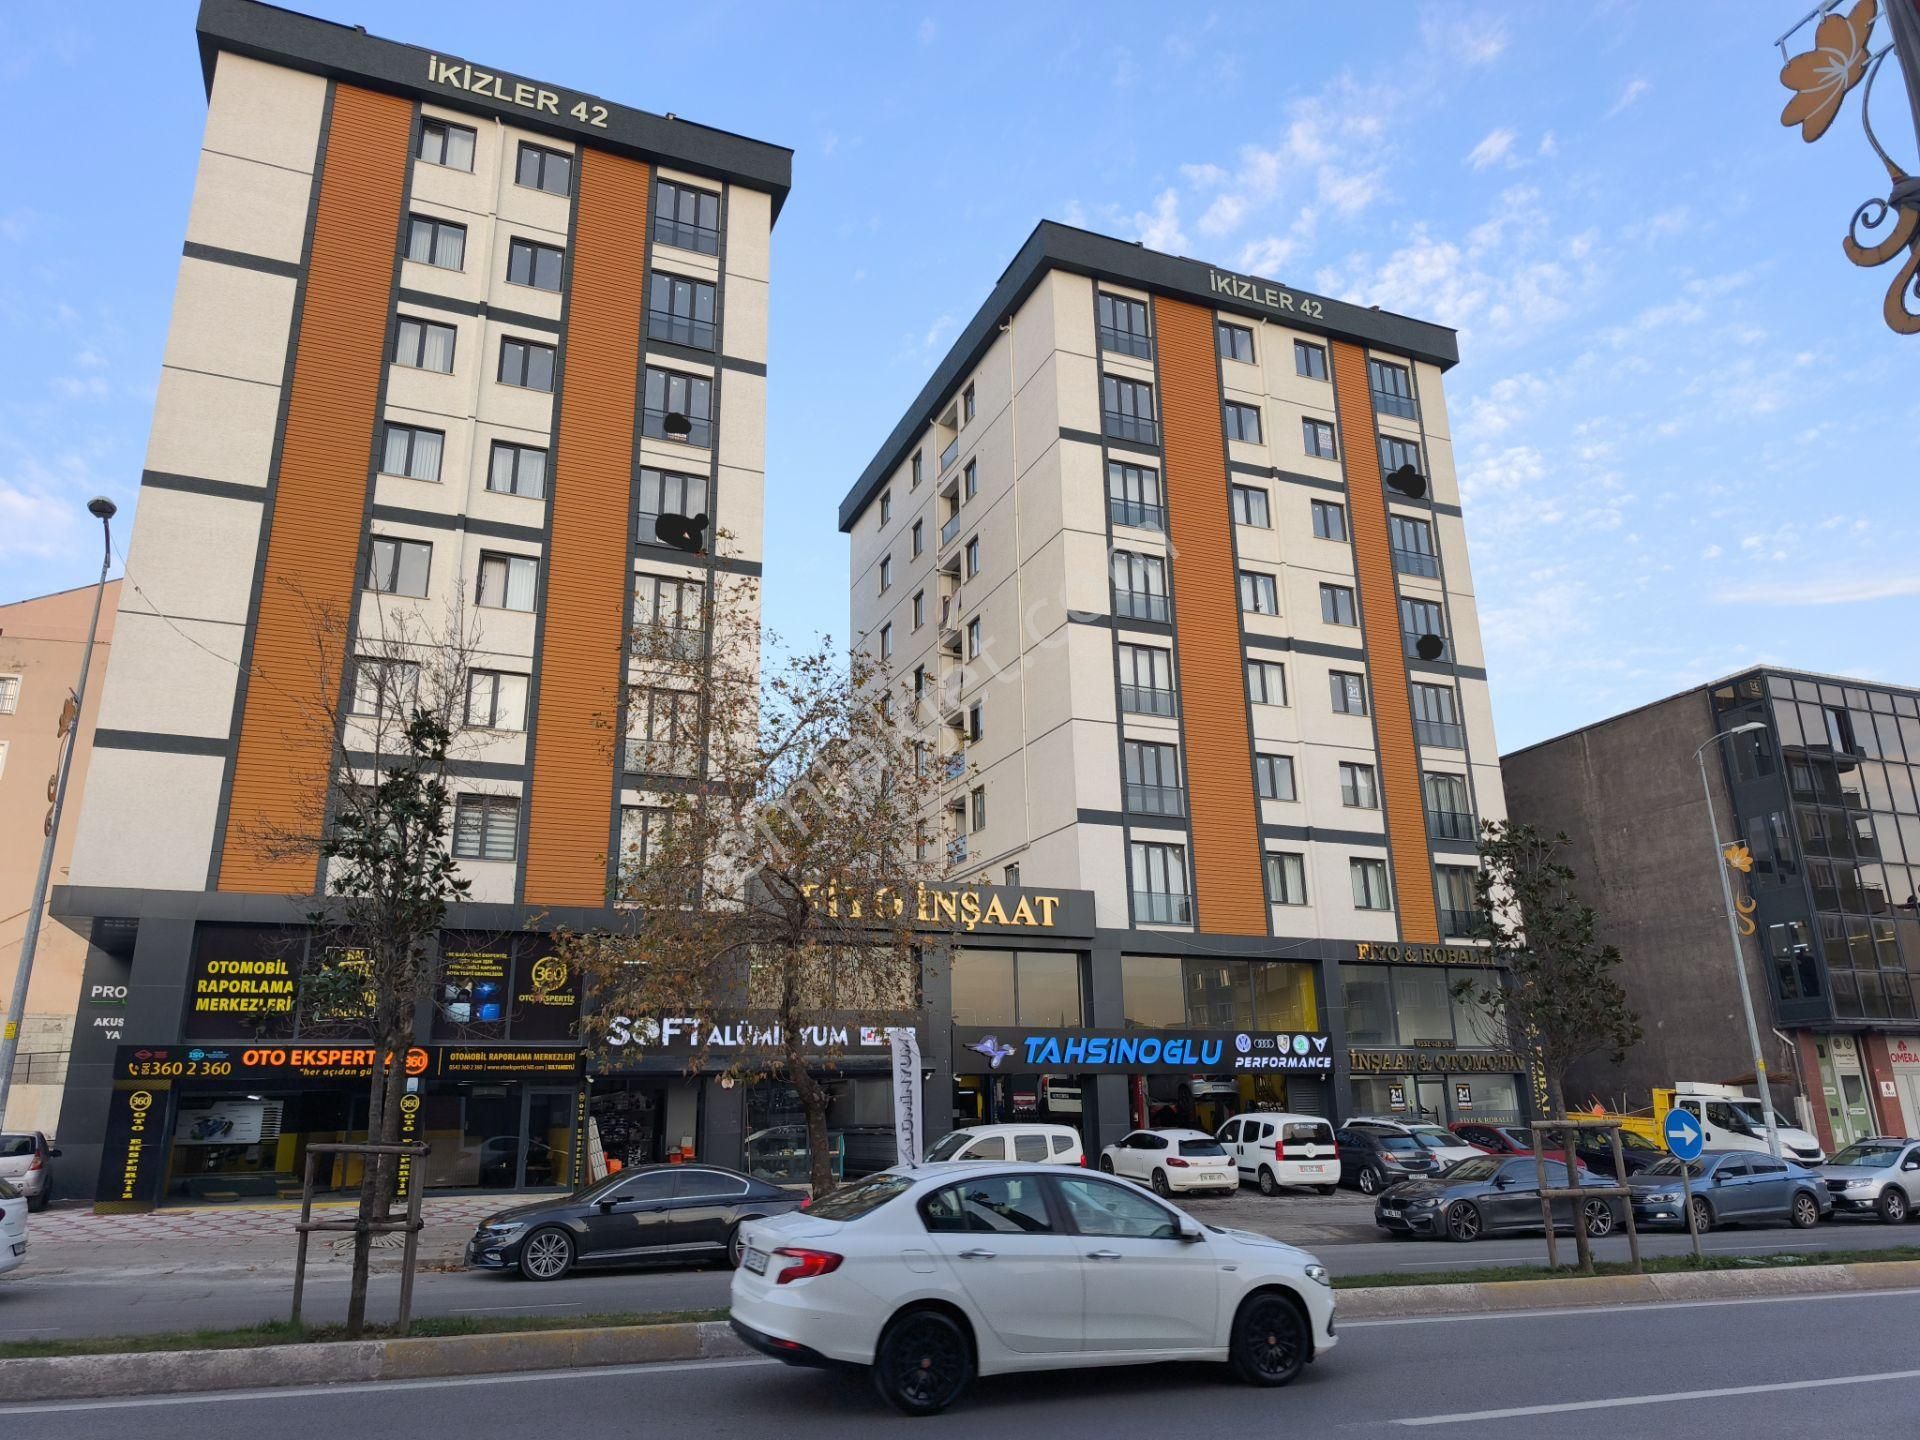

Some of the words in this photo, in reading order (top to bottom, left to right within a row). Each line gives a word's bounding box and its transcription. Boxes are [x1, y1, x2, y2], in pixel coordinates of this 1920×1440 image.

[428, 55, 559, 115] İKİZLER
[570, 101, 608, 128] 42
[1209, 269, 1295, 312] İKİZLER
[1300, 298, 1323, 319] 42
[1404, 945, 1419, 962] &
[207, 960, 289, 975] OTOMOBİL
[197, 980, 294, 993] RAPORLAMA
[706, 1019, 848, 1046] ALÜMİYUM
[243, 1050, 286, 1066] OTO
[450, 1052, 486, 1061] OTOMOBİL
[489, 1052, 532, 1061] RAPORLAMA
[534, 1052, 576, 1061] MERKEZLERİ
[1235, 1056, 1332, 1068] PERFORMANCE
[1417, 1054, 1432, 1071] &
[151, 1061, 183, 1076] 360
[186, 1062, 197, 1075] 2
[200, 1061, 231, 1076] 360
[133, 1096, 149, 1106] 360
